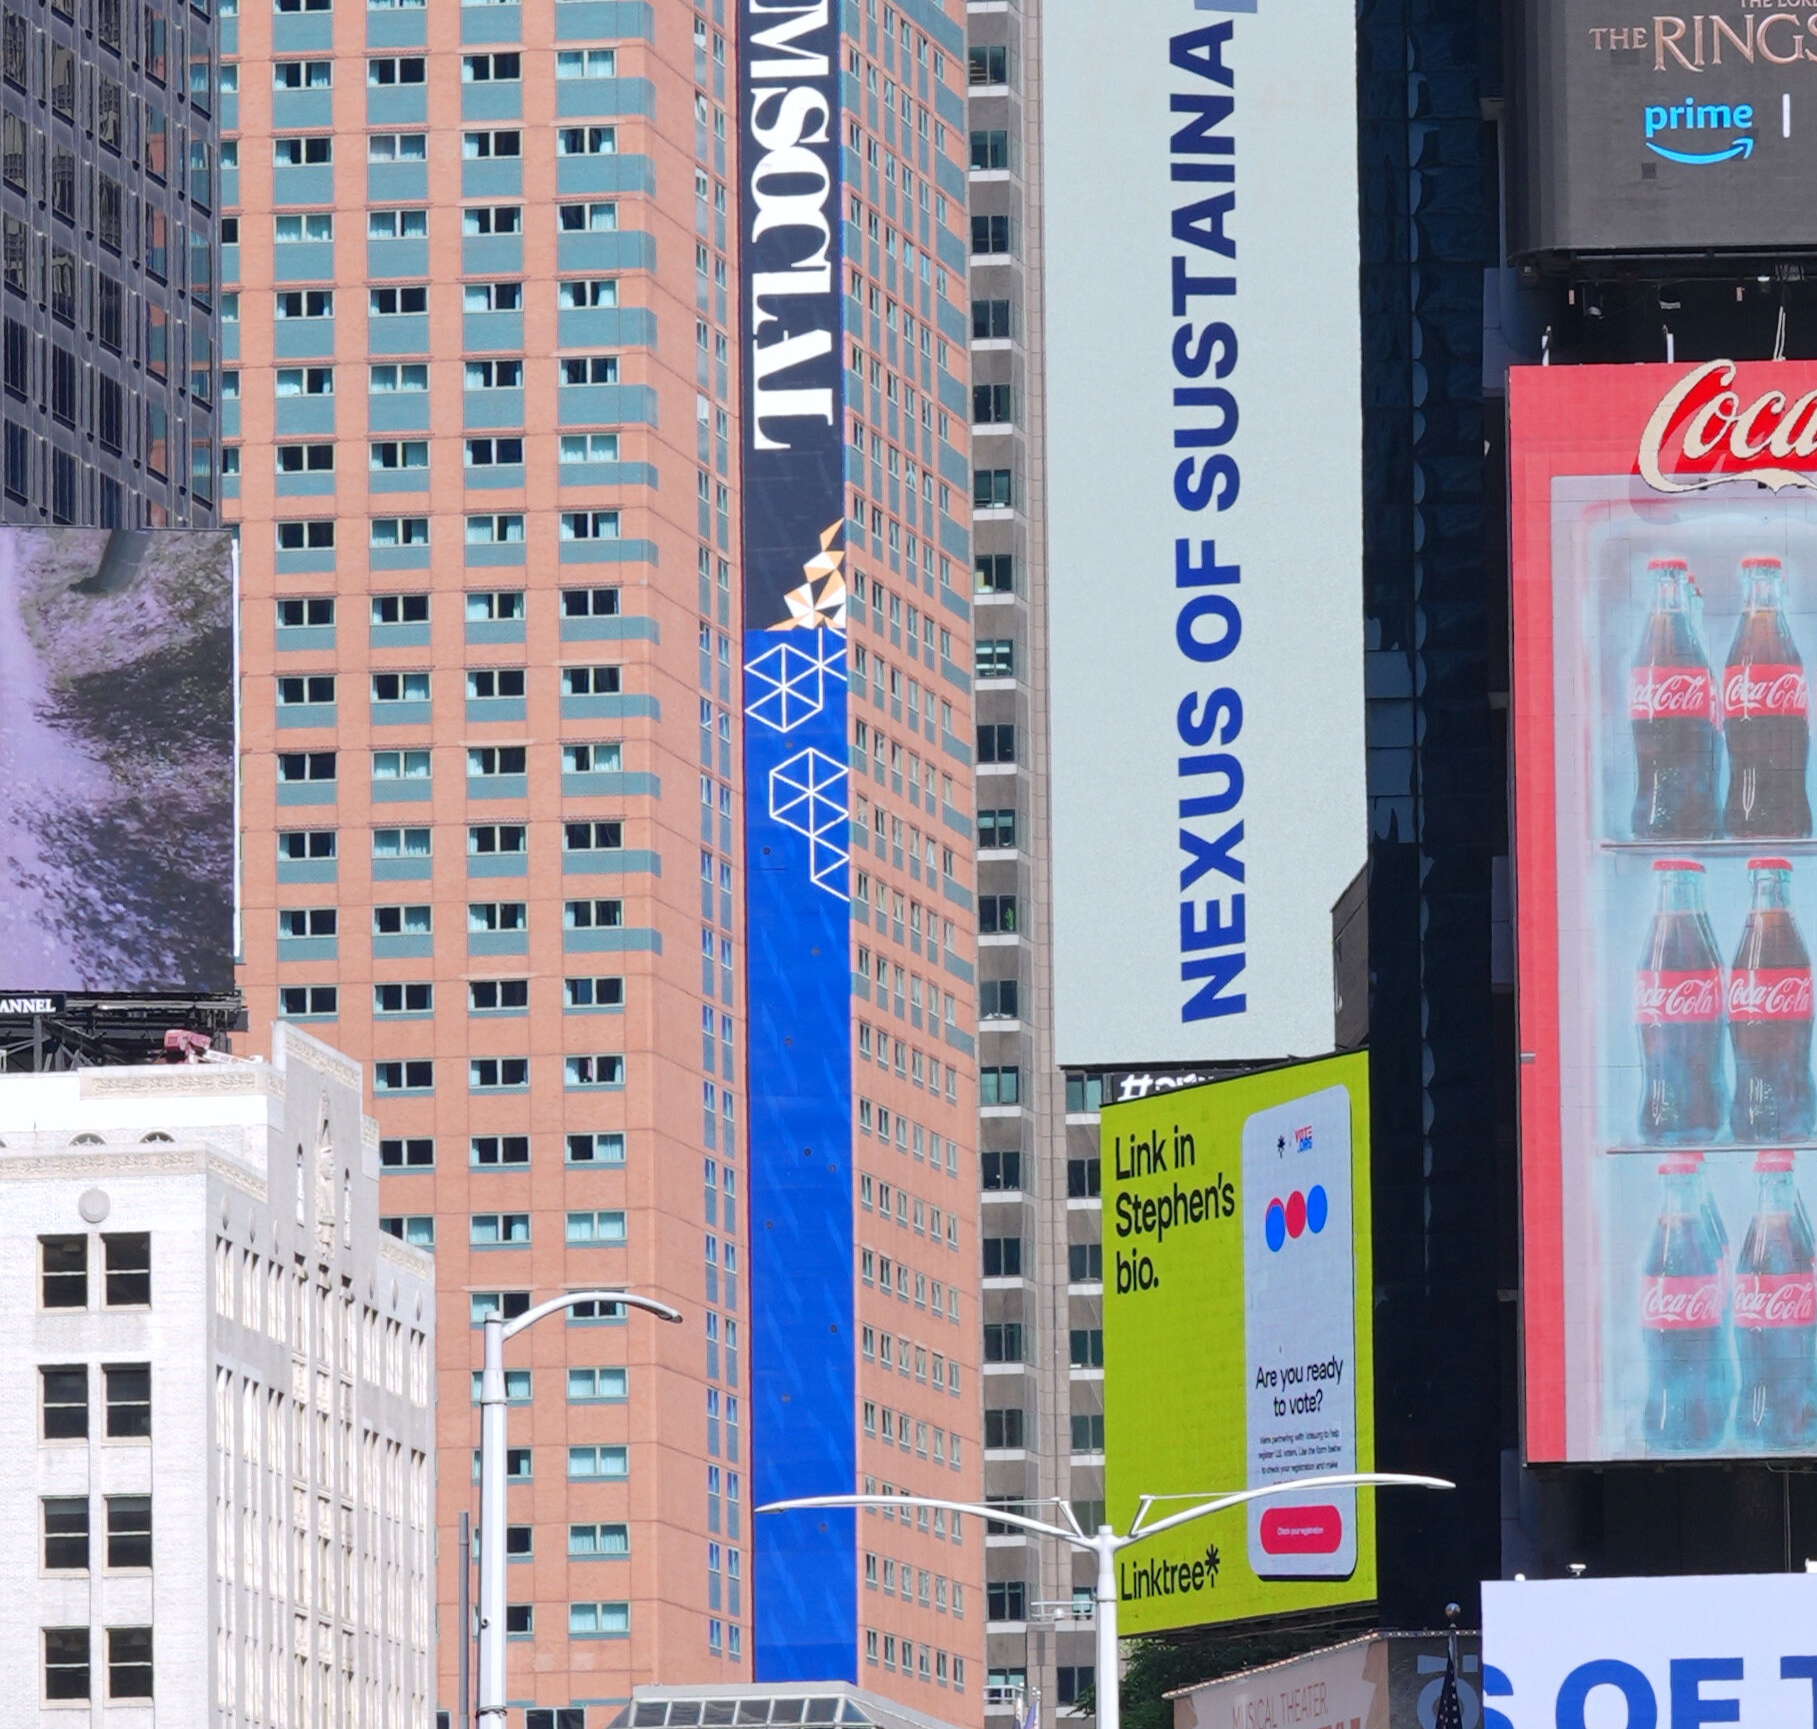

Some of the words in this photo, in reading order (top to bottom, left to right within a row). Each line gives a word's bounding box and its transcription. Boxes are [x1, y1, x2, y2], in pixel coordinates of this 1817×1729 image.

[1589, 26, 1647, 51] THE
[1644, 100, 1753, 135] prime
[1175, 538, 1243, 665] OF
[1179, 691, 1250, 1024] NEXUS
[1116, 1128, 1168, 1181] Link
[1174, 1124, 1196, 1170] in
[1116, 1172, 1236, 1243] Stephen's
[1116, 1247, 1159, 1295] bio.
[1256, 1366, 1277, 1390] Are
[1281, 1364, 1304, 1392] you
[1306, 1357, 1344, 1386] ready
[1274, 1396, 1286, 1417] to
[1289, 1388, 1323, 1415] vote?
